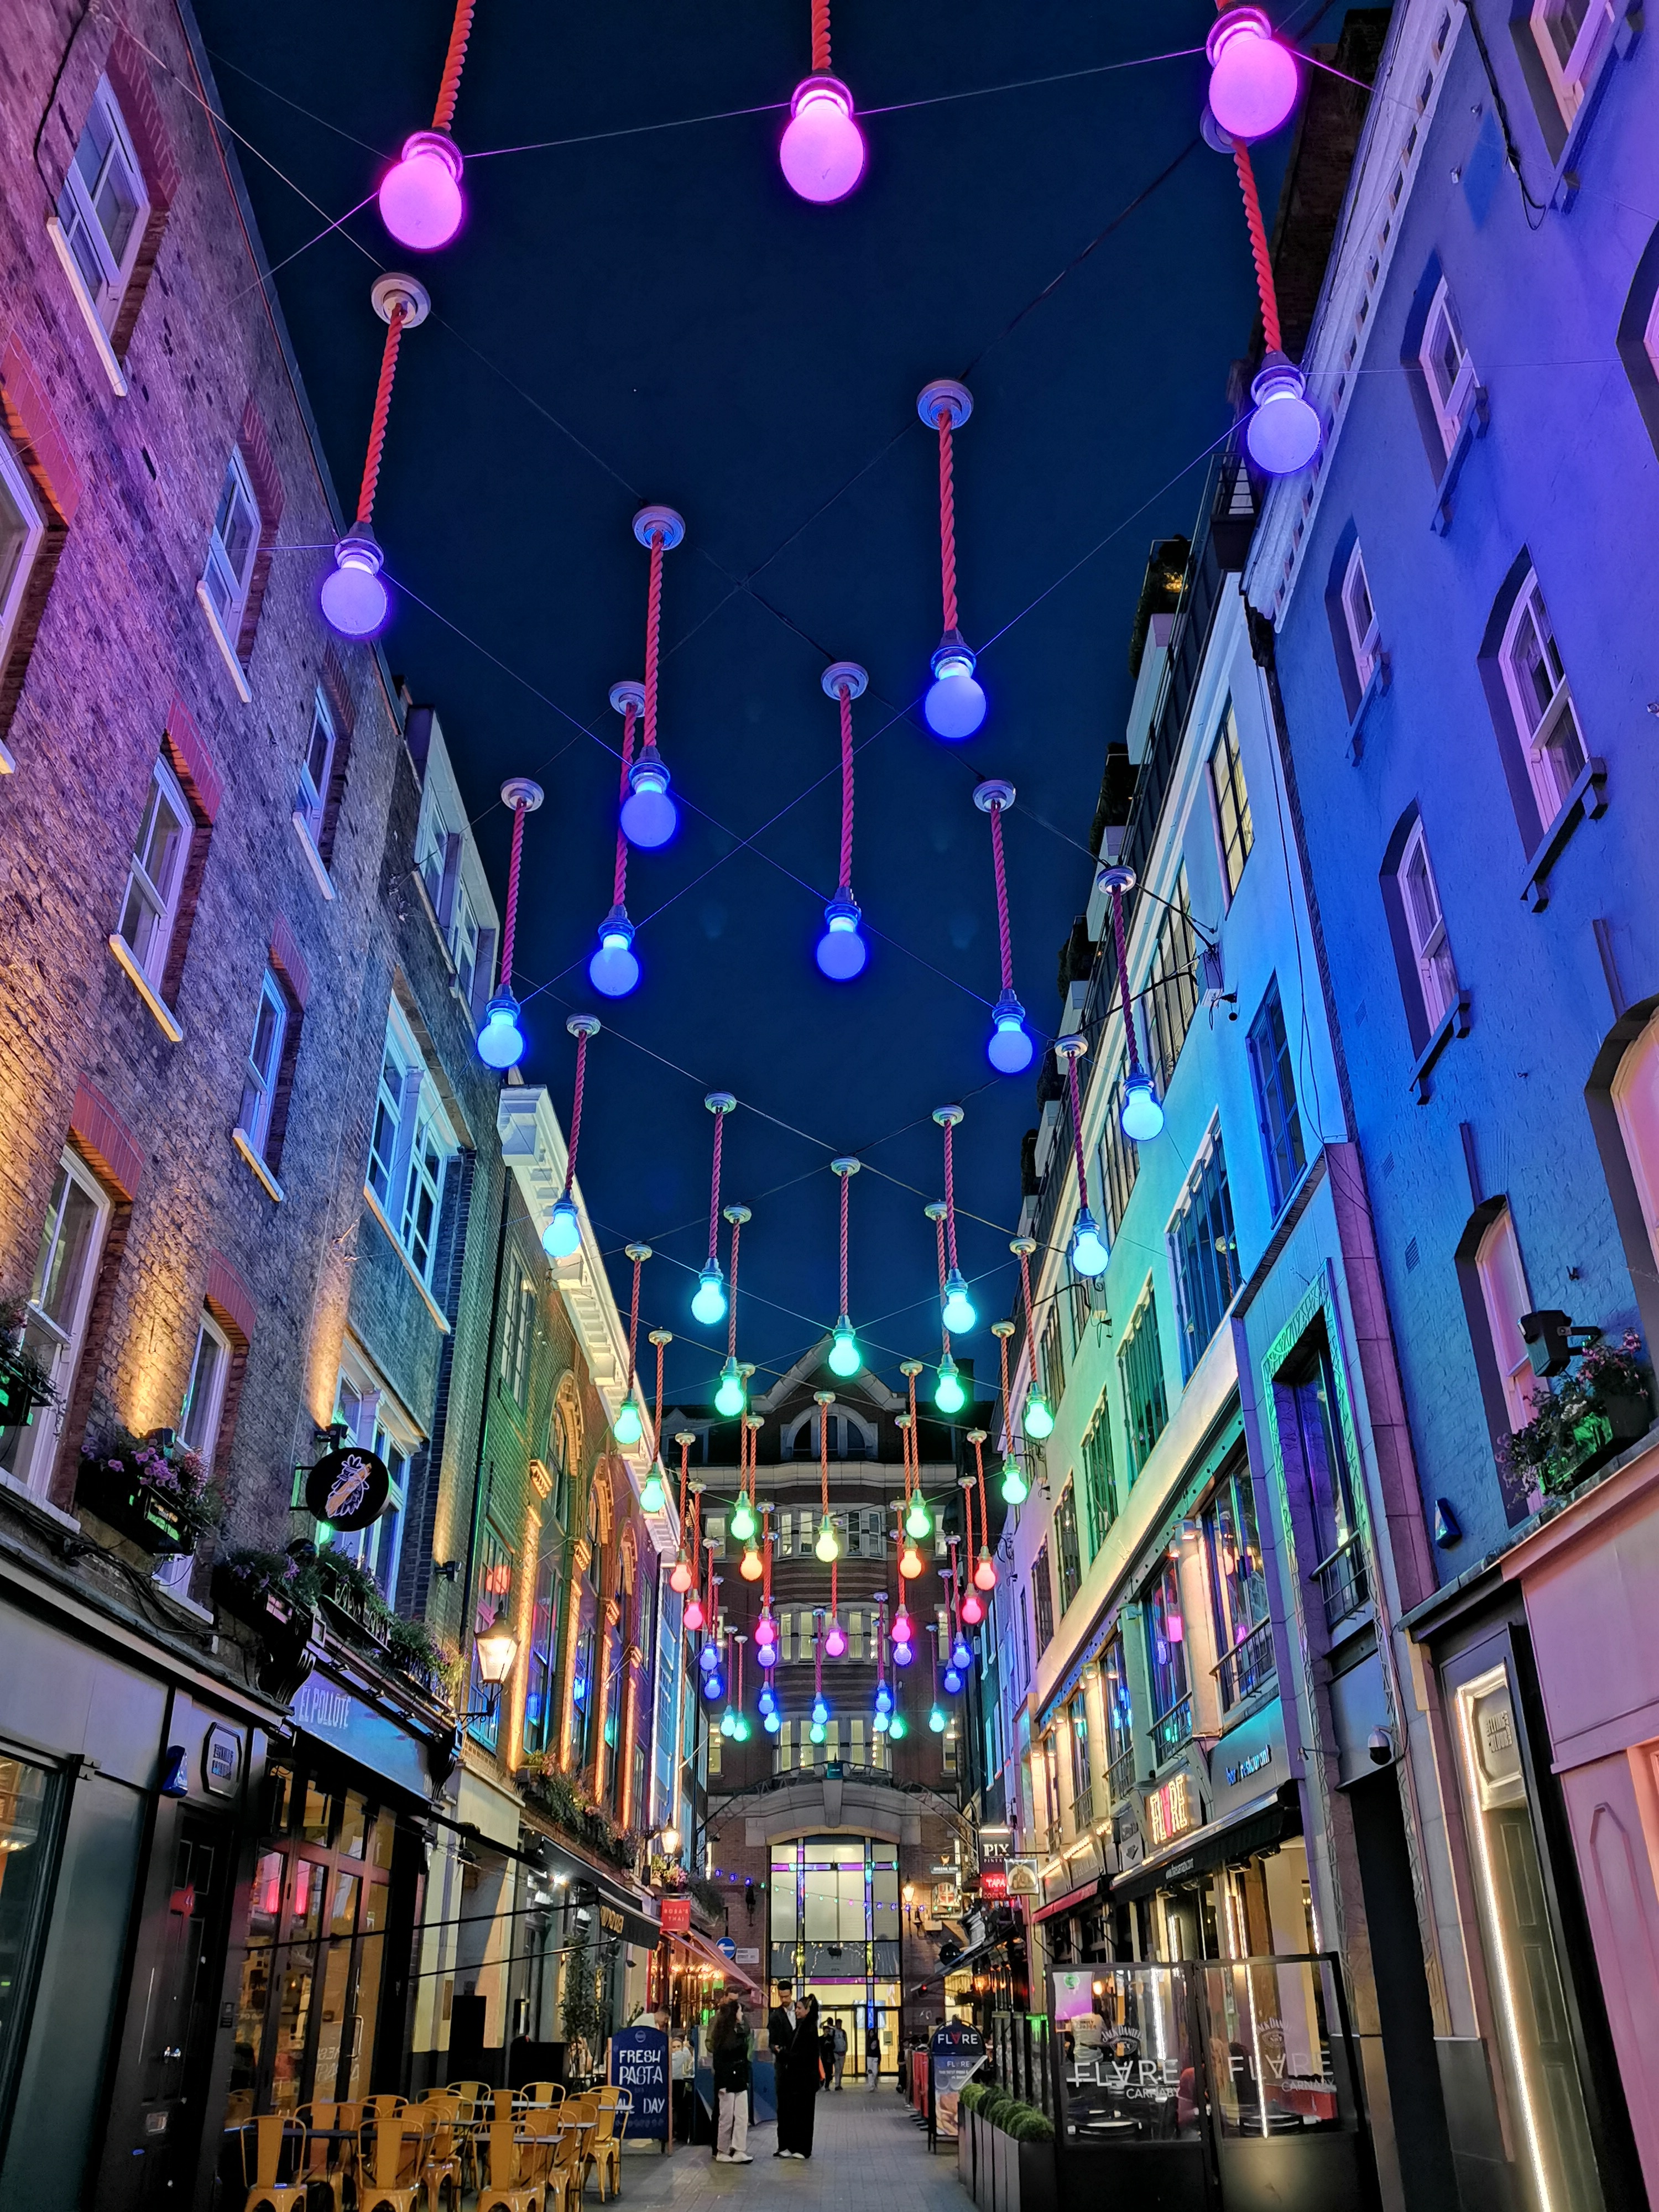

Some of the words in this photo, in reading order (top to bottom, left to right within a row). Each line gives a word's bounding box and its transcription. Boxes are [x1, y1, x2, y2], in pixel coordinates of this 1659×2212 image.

[299, 1686, 311, 1722] EL
[983, 1843, 1010, 1857] PIX
[985, 1878, 1006, 1888] TAPA
[619, 2049, 661, 2064] FRESH
[619, 2065, 663, 2085] PASTA
[1126, 2087, 1180, 2100] CARNABY
[615, 2098, 635, 2114] AL
[643, 2098, 665, 2114] DAY
